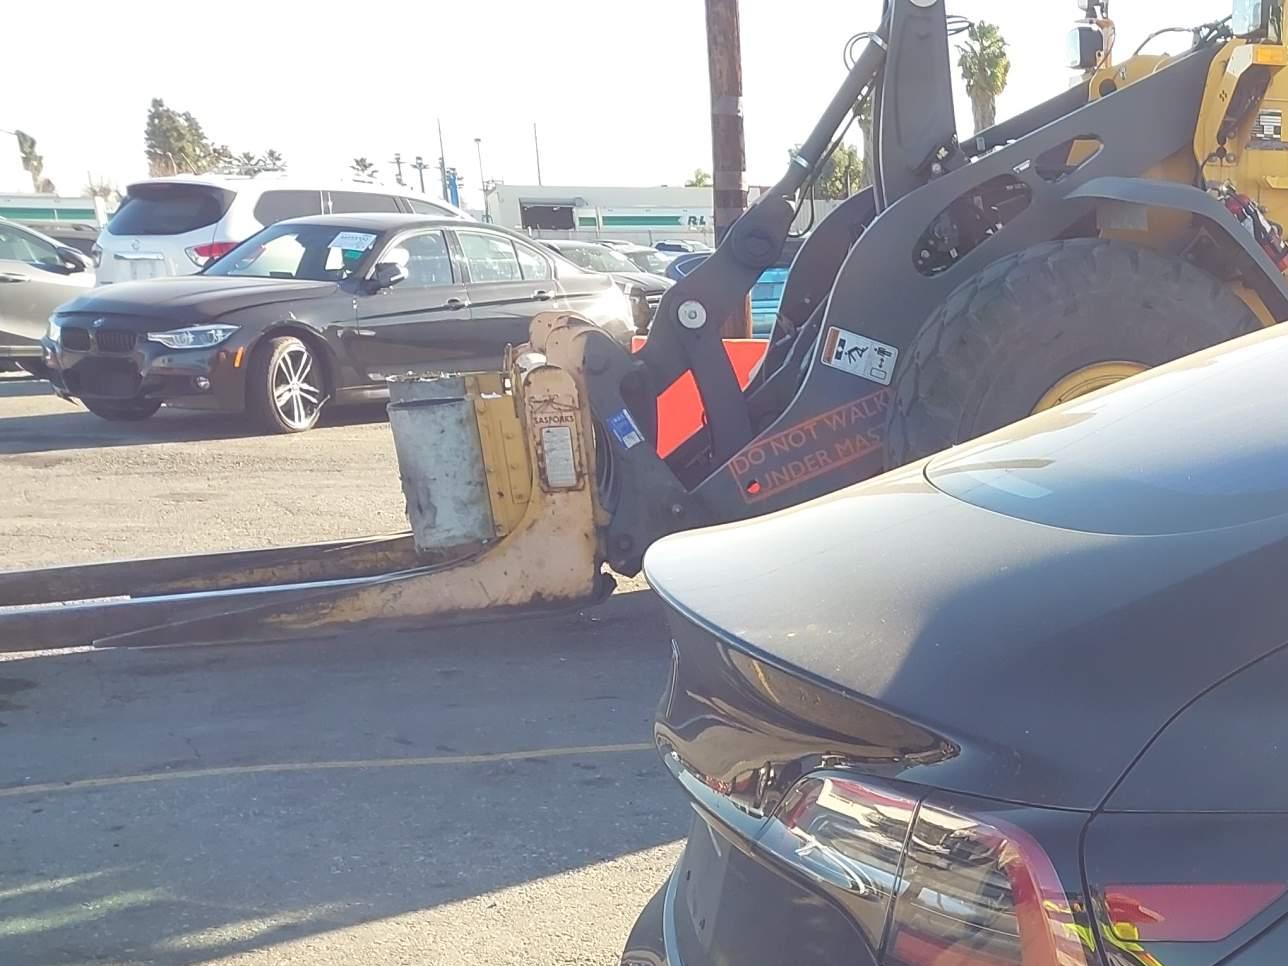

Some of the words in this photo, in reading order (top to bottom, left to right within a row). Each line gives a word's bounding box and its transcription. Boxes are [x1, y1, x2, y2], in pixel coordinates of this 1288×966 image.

[734, 447, 766, 475] DO
[769, 422, 818, 456] NOT
[823, 391, 888, 432] WALK
[834, 424, 883, 459] MAS
